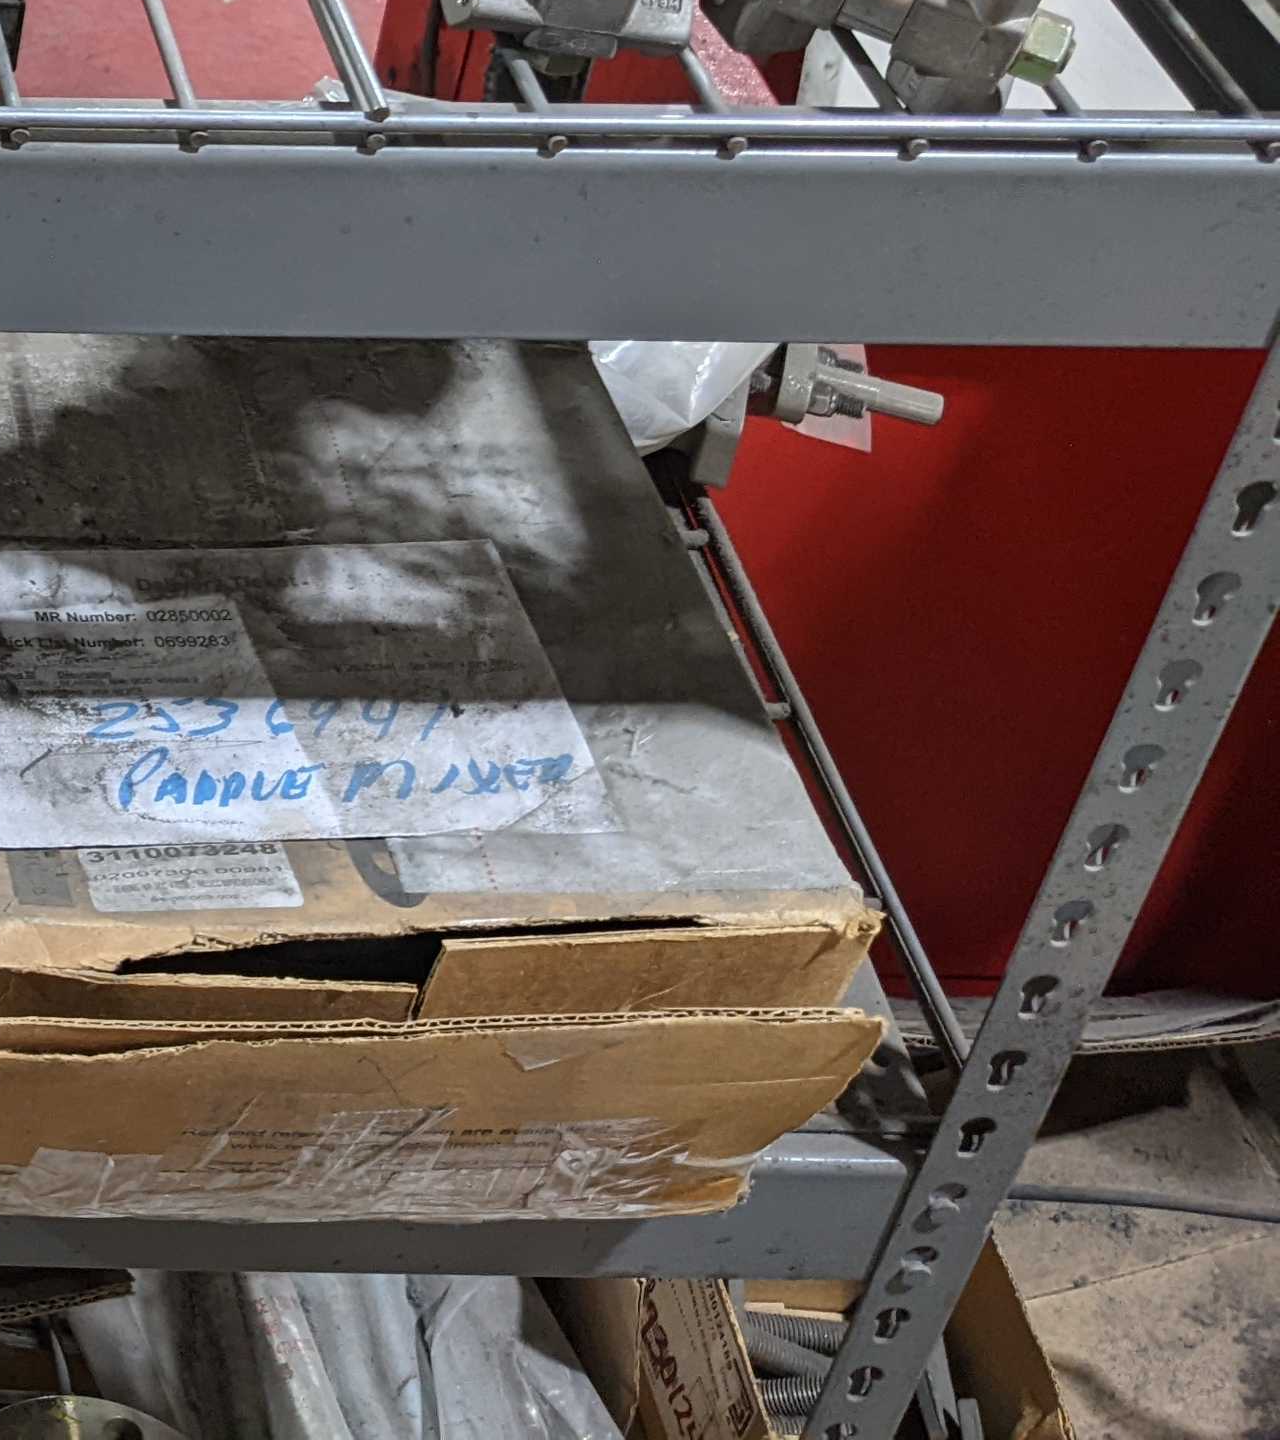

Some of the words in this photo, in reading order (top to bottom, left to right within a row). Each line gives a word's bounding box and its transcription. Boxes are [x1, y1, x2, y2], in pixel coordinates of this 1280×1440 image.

[35, 612, 62, 622] MR
[67, 611, 137, 623] Number:
[146, 609, 233, 622] 02850002
[154, 636, 231, 648] 0699283
[117, 745, 324, 812] PADDLE
[341, 753, 574, 804] MIXER
